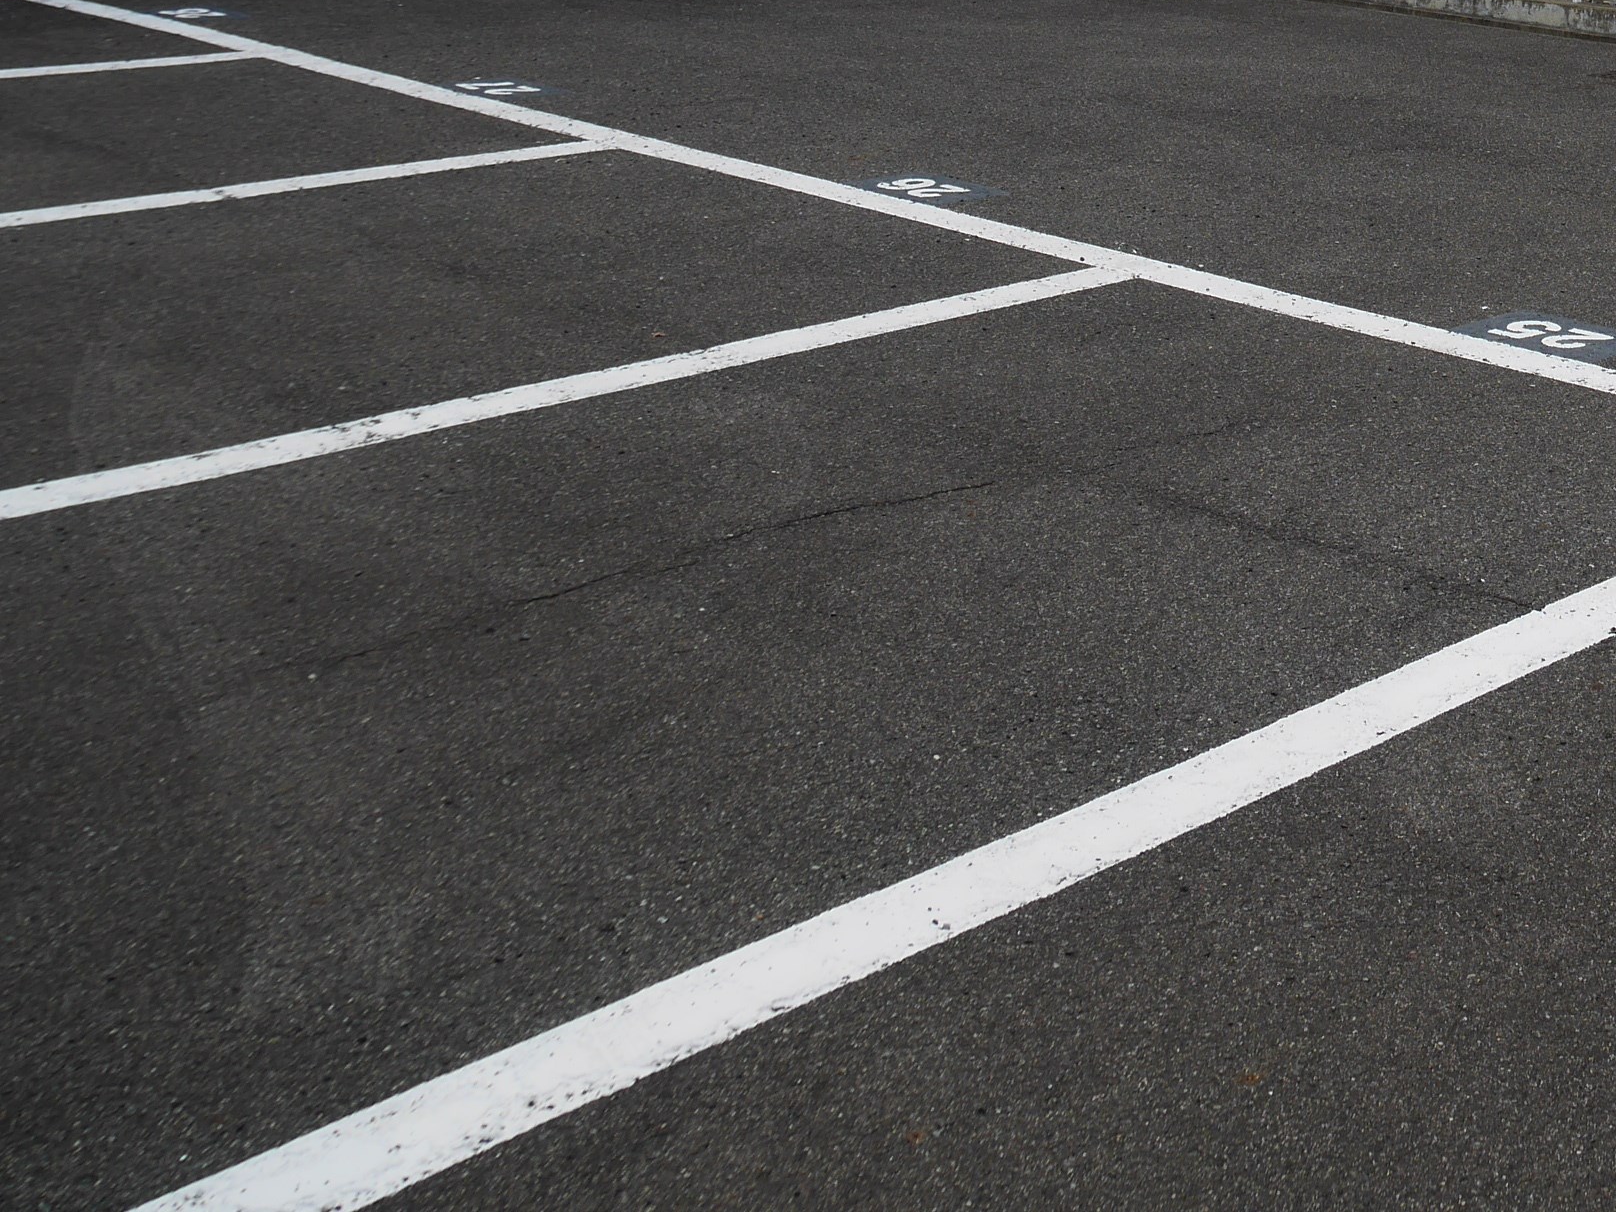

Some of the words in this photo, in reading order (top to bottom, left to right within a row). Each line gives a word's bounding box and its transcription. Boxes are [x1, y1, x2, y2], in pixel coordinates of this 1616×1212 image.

[455, 81, 542, 96] 27
[877, 177, 972, 198] 26
[1487, 320, 1615, 349] 25
